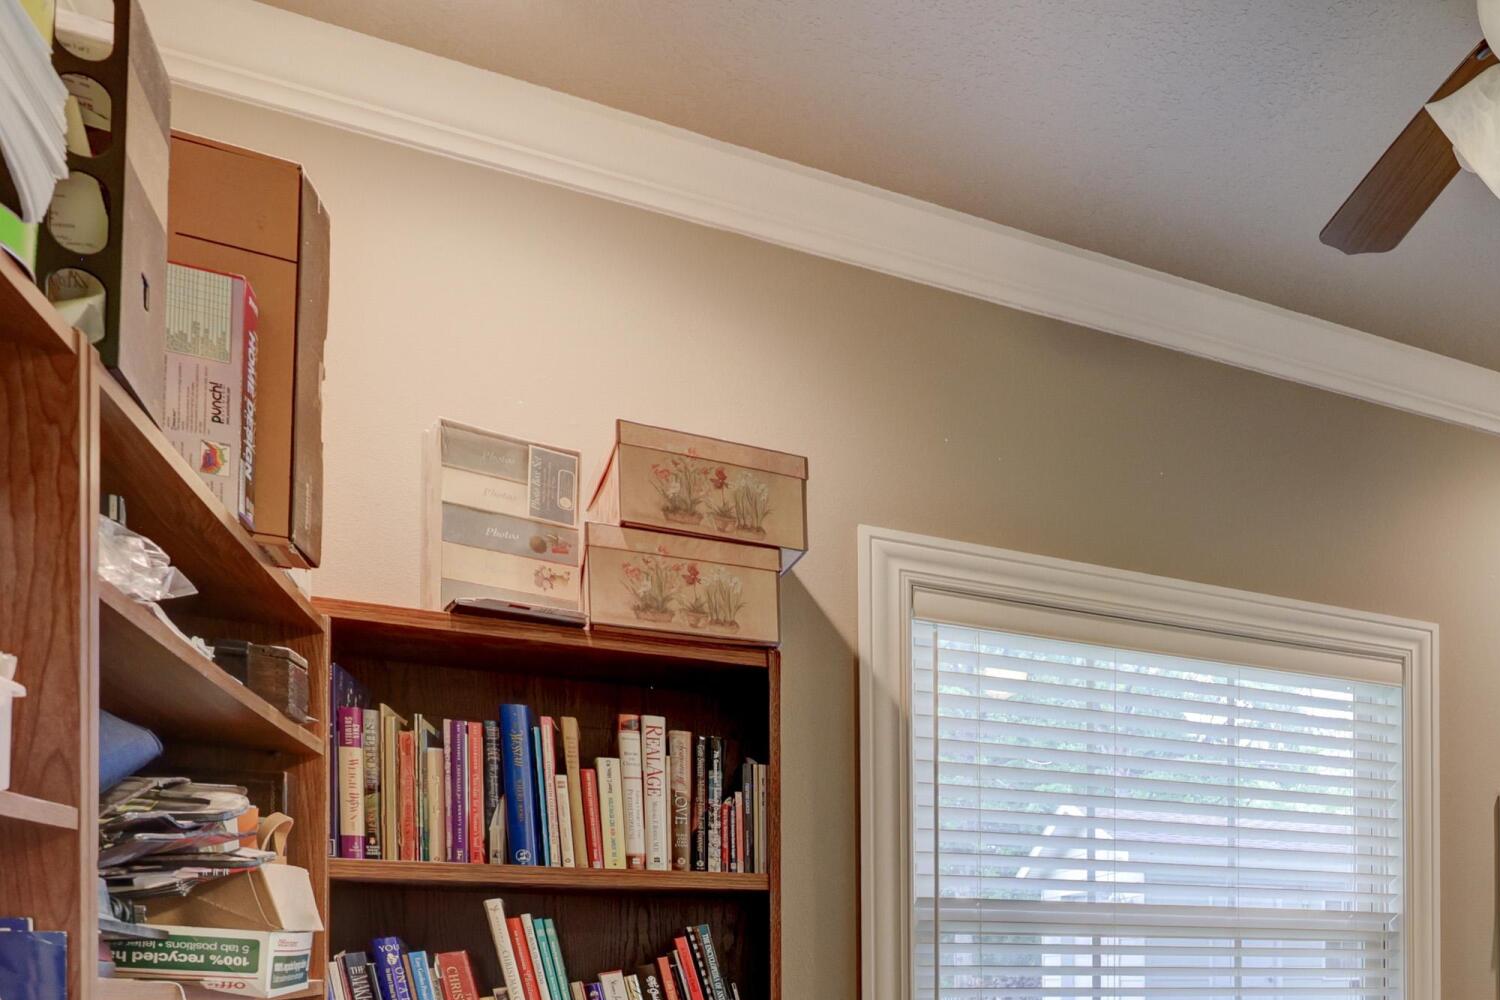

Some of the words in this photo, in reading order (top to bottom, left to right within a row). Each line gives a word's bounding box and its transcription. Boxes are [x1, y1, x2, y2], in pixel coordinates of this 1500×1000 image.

[211, 382, 223, 424] punch!
[485, 527, 520, 540] Photos
[674, 790, 688, 825] LOVE
[701, 933, 711, 943] THE
[165, 940, 218, 953] positions
[220, 943, 240, 953] tab
[242, 945, 250, 954] 5
[379, 944, 401, 952] YOU
[131, 949, 205, 964] recycled
[209, 953, 251, 966] 100%
[394, 967, 408, 983] ON
[399, 986, 409, 994] A
